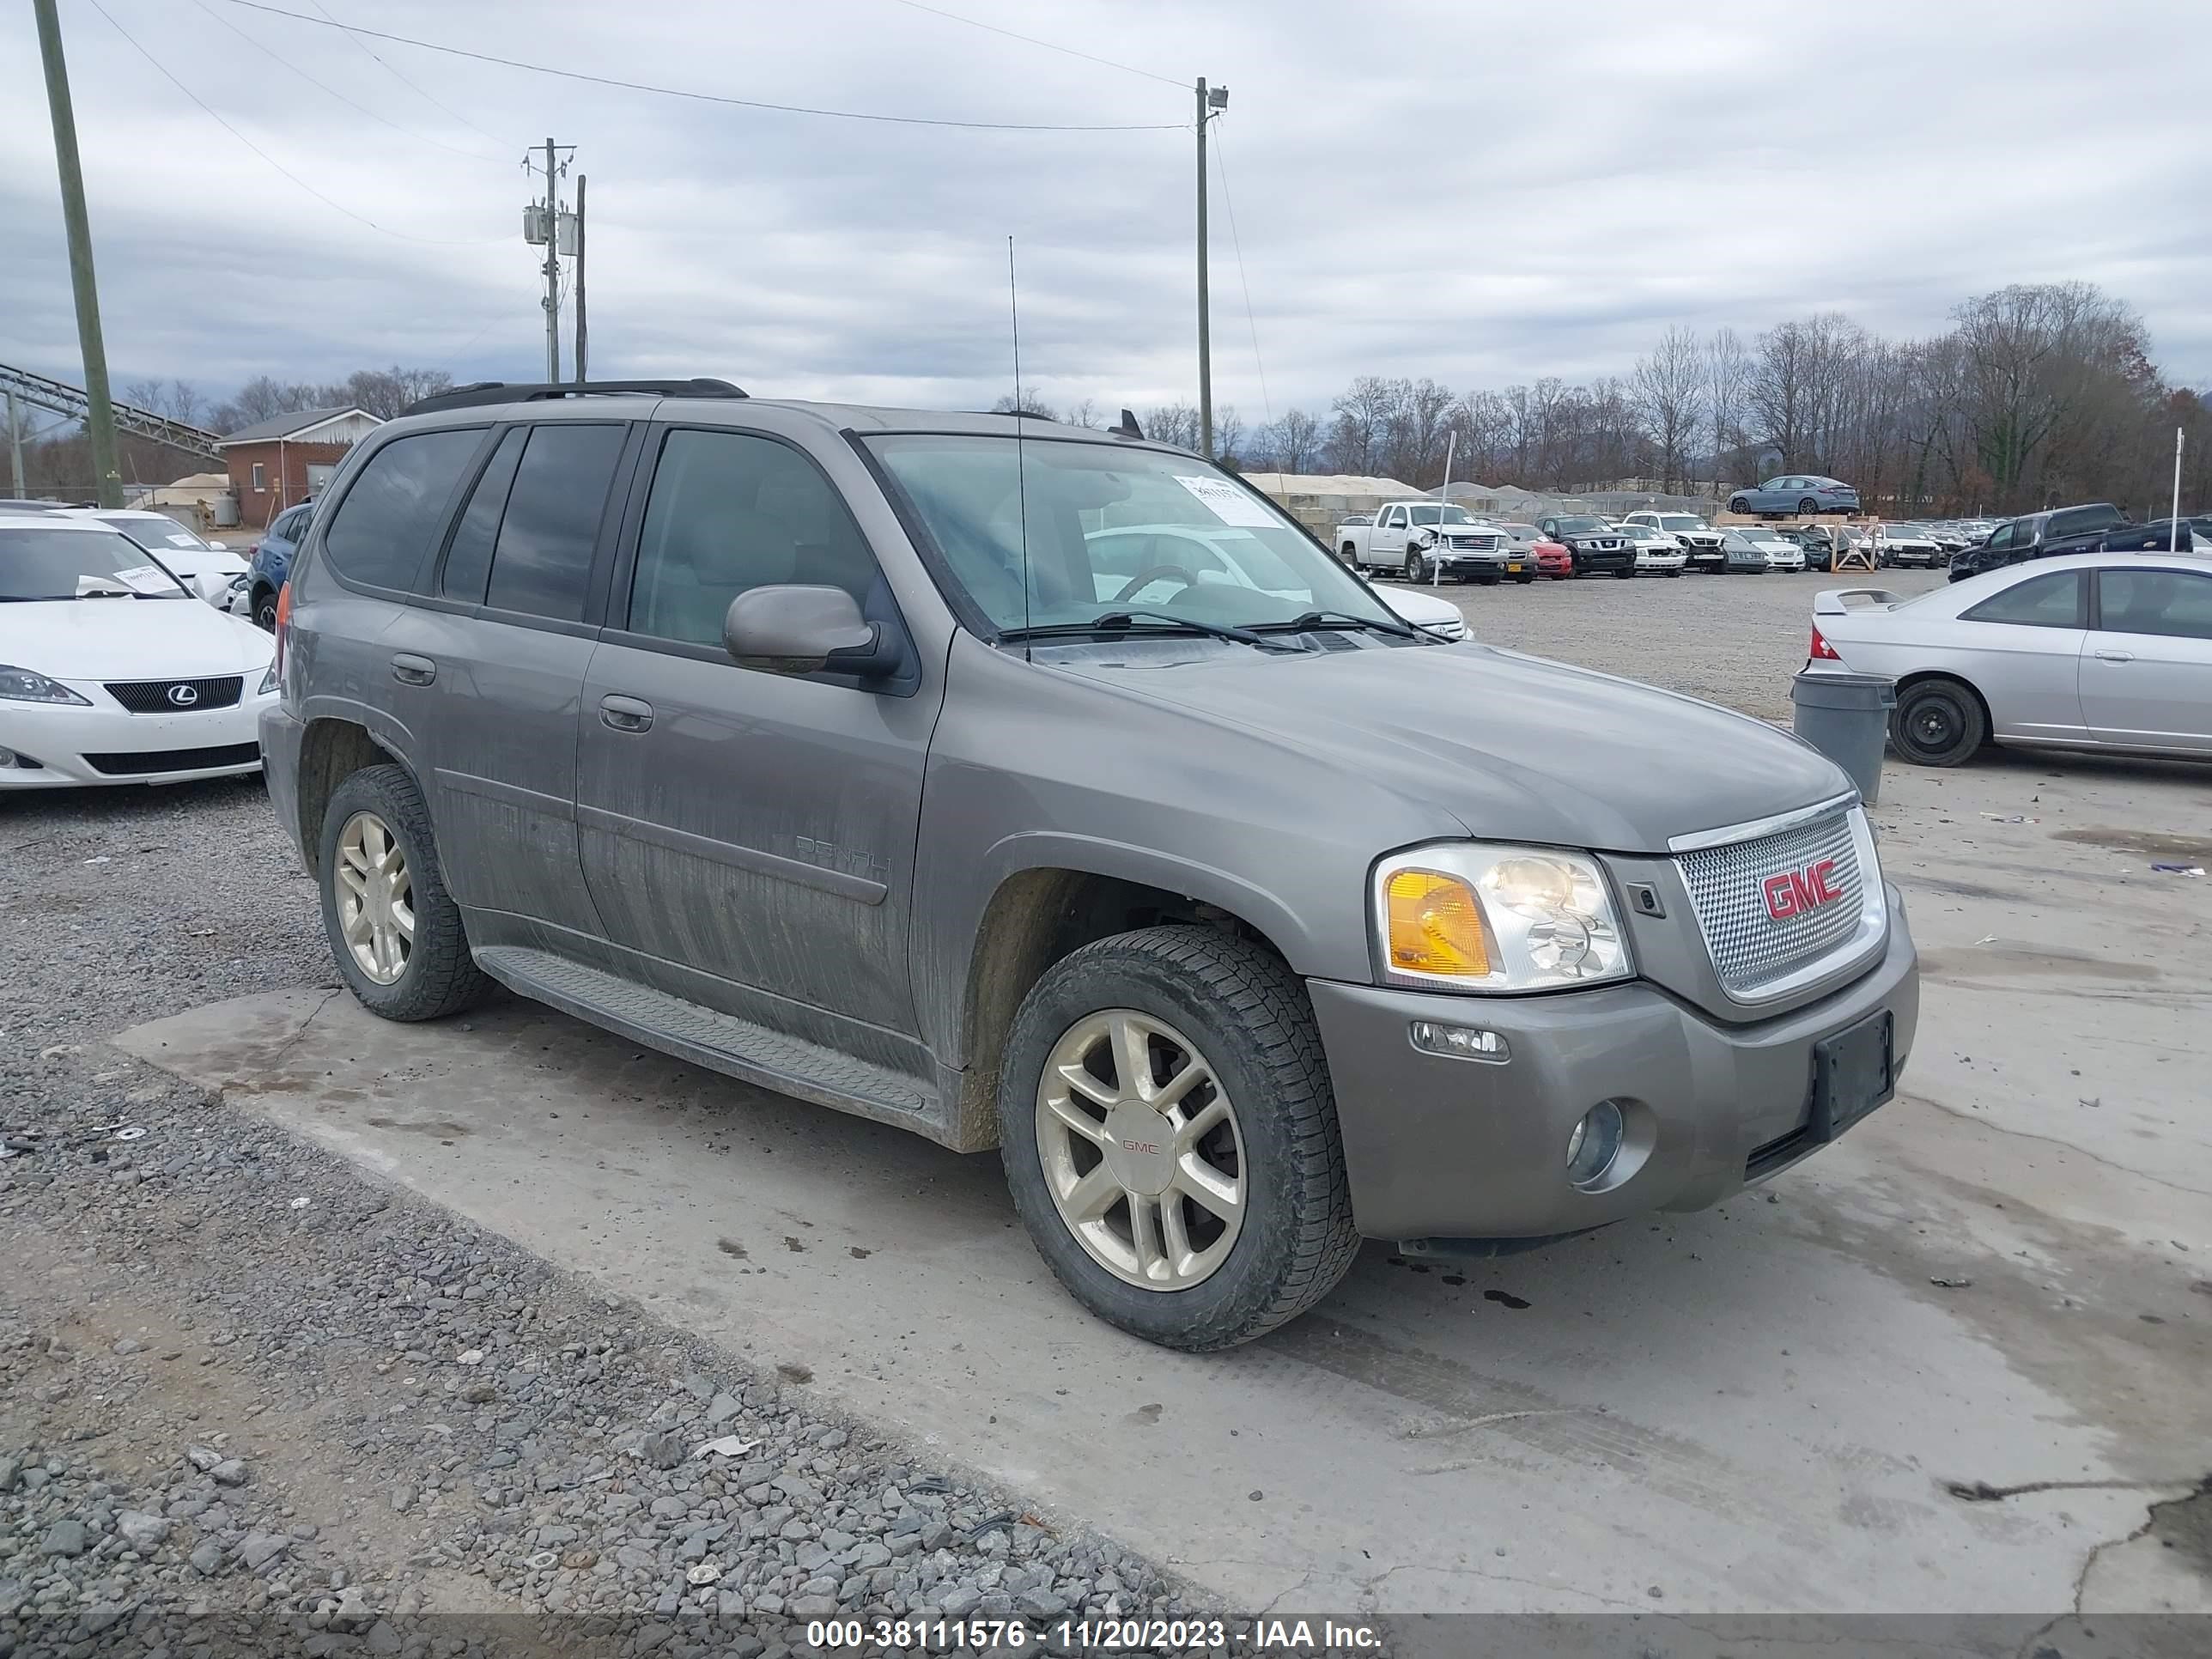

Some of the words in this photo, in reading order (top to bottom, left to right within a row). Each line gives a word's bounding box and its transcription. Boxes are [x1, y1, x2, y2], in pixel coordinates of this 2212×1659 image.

[796, 836, 891, 873] DENALI
[1760, 858, 1842, 919] GMC
[1122, 1139, 1160, 1155] GMC
